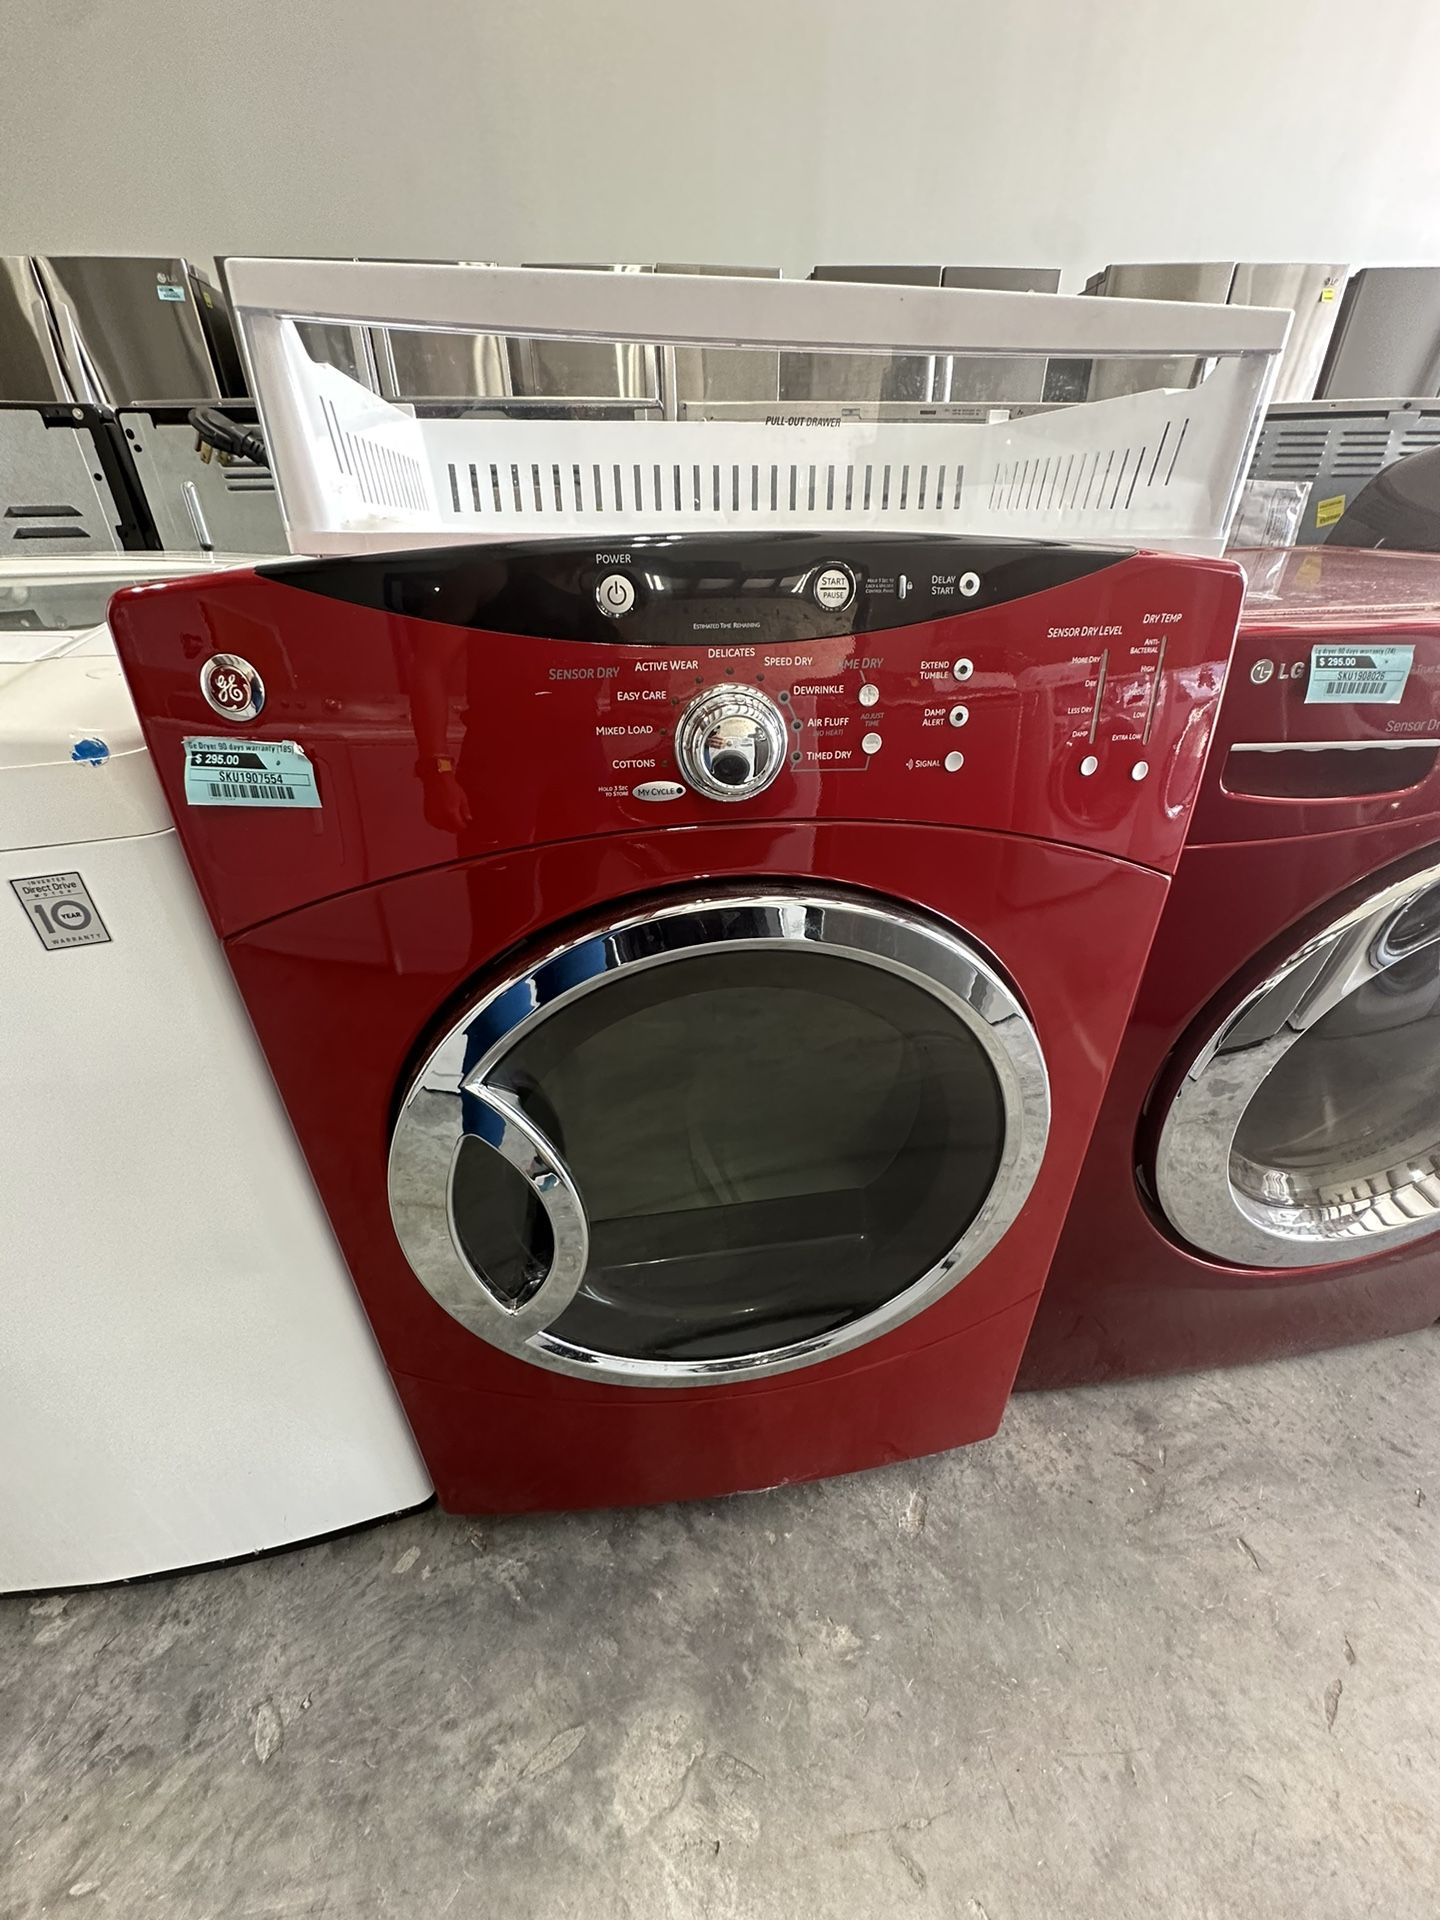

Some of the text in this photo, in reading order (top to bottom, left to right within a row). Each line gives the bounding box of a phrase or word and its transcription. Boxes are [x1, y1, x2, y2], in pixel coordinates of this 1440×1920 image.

[765, 416, 841, 428] PULL-OUT DRAWER
[595, 553, 632, 565] POWER
[821, 577, 845, 585] START
[931, 575, 957, 585] DELAY
[931, 586, 954, 595] START
[1143, 613, 1182, 624] DRY TEMP
[1047, 626, 1123, 638] SENSOR DRY LEVEL
[708, 648, 755, 658] DELICATES
[635, 660, 699, 672] ACTIVE WEAR
[765, 656, 813, 666] SPEED DRY
[861, 657, 884, 669] DRY
[920, 661, 950, 670] EXTEND
[1319, 657, 1356, 667] $ 295.00
[549, 667, 620, 681] SENSOR DRY
[920, 671, 949, 680] TUMBLE
[1278, 661, 1305, 680] LG
[1337, 671, 1385, 681] SKU1908026
[617, 690, 667, 701] EASY CARE
[793, 685, 845, 696] DEWRINKLE
[860, 712, 885, 720] ADJUST
[924, 709, 946, 718] DAMP
[1068, 707, 1080, 715] LESS
[807, 717, 849, 727] AIR FLUFF
[922, 718, 945, 727] ALERT
[1386, 720, 1426, 732] Sensor
[596, 725, 654, 736] MIXED LOAD
[1112, 734, 1128, 742] EXTRA
[218, 743, 227, 751] 90
[229, 743, 244, 752] days
[246, 745, 275, 753] warranty
[195, 754, 240, 765] $ 295.00
[806, 750, 852, 761] TIMED DRY
[612, 759, 656, 769] COTTONS
[915, 760, 941, 769] SIGNAL
[219, 771, 283, 784] SKU1907554
[651, 788, 675, 796] CYCLE
[27, 877, 66, 886] INVERTER
[22, 880, 77, 895] Direct Drive
[34, 889, 71, 898] MOTOR
[34, 900, 92, 934] 10
[61, 912, 82, 920] YEAR
[52, 934, 102, 945] WARRANTY
